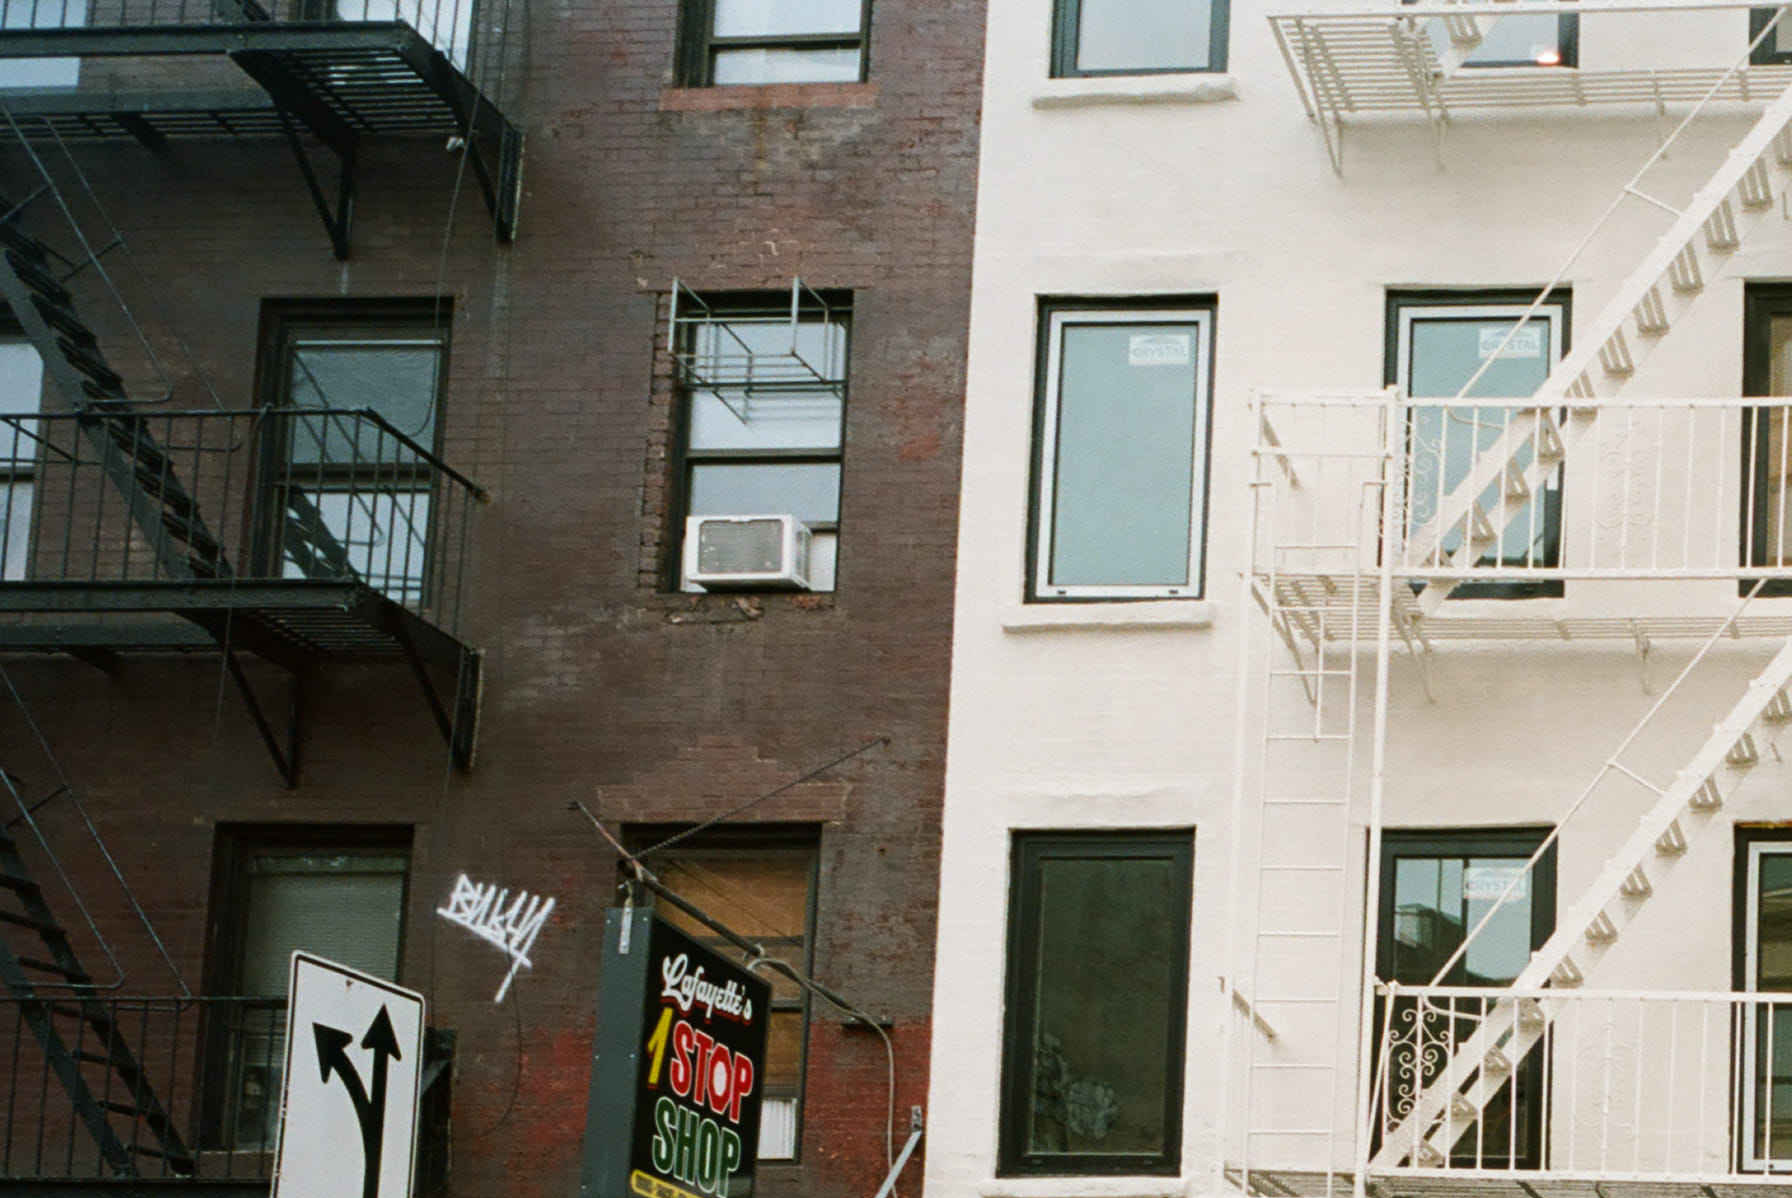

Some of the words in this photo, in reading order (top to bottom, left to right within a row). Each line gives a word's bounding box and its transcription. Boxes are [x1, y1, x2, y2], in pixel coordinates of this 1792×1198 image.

[662, 953, 752, 1020] Lafayette's
[647, 1006, 673, 1085] 1
[670, 1019, 754, 1124] STOP
